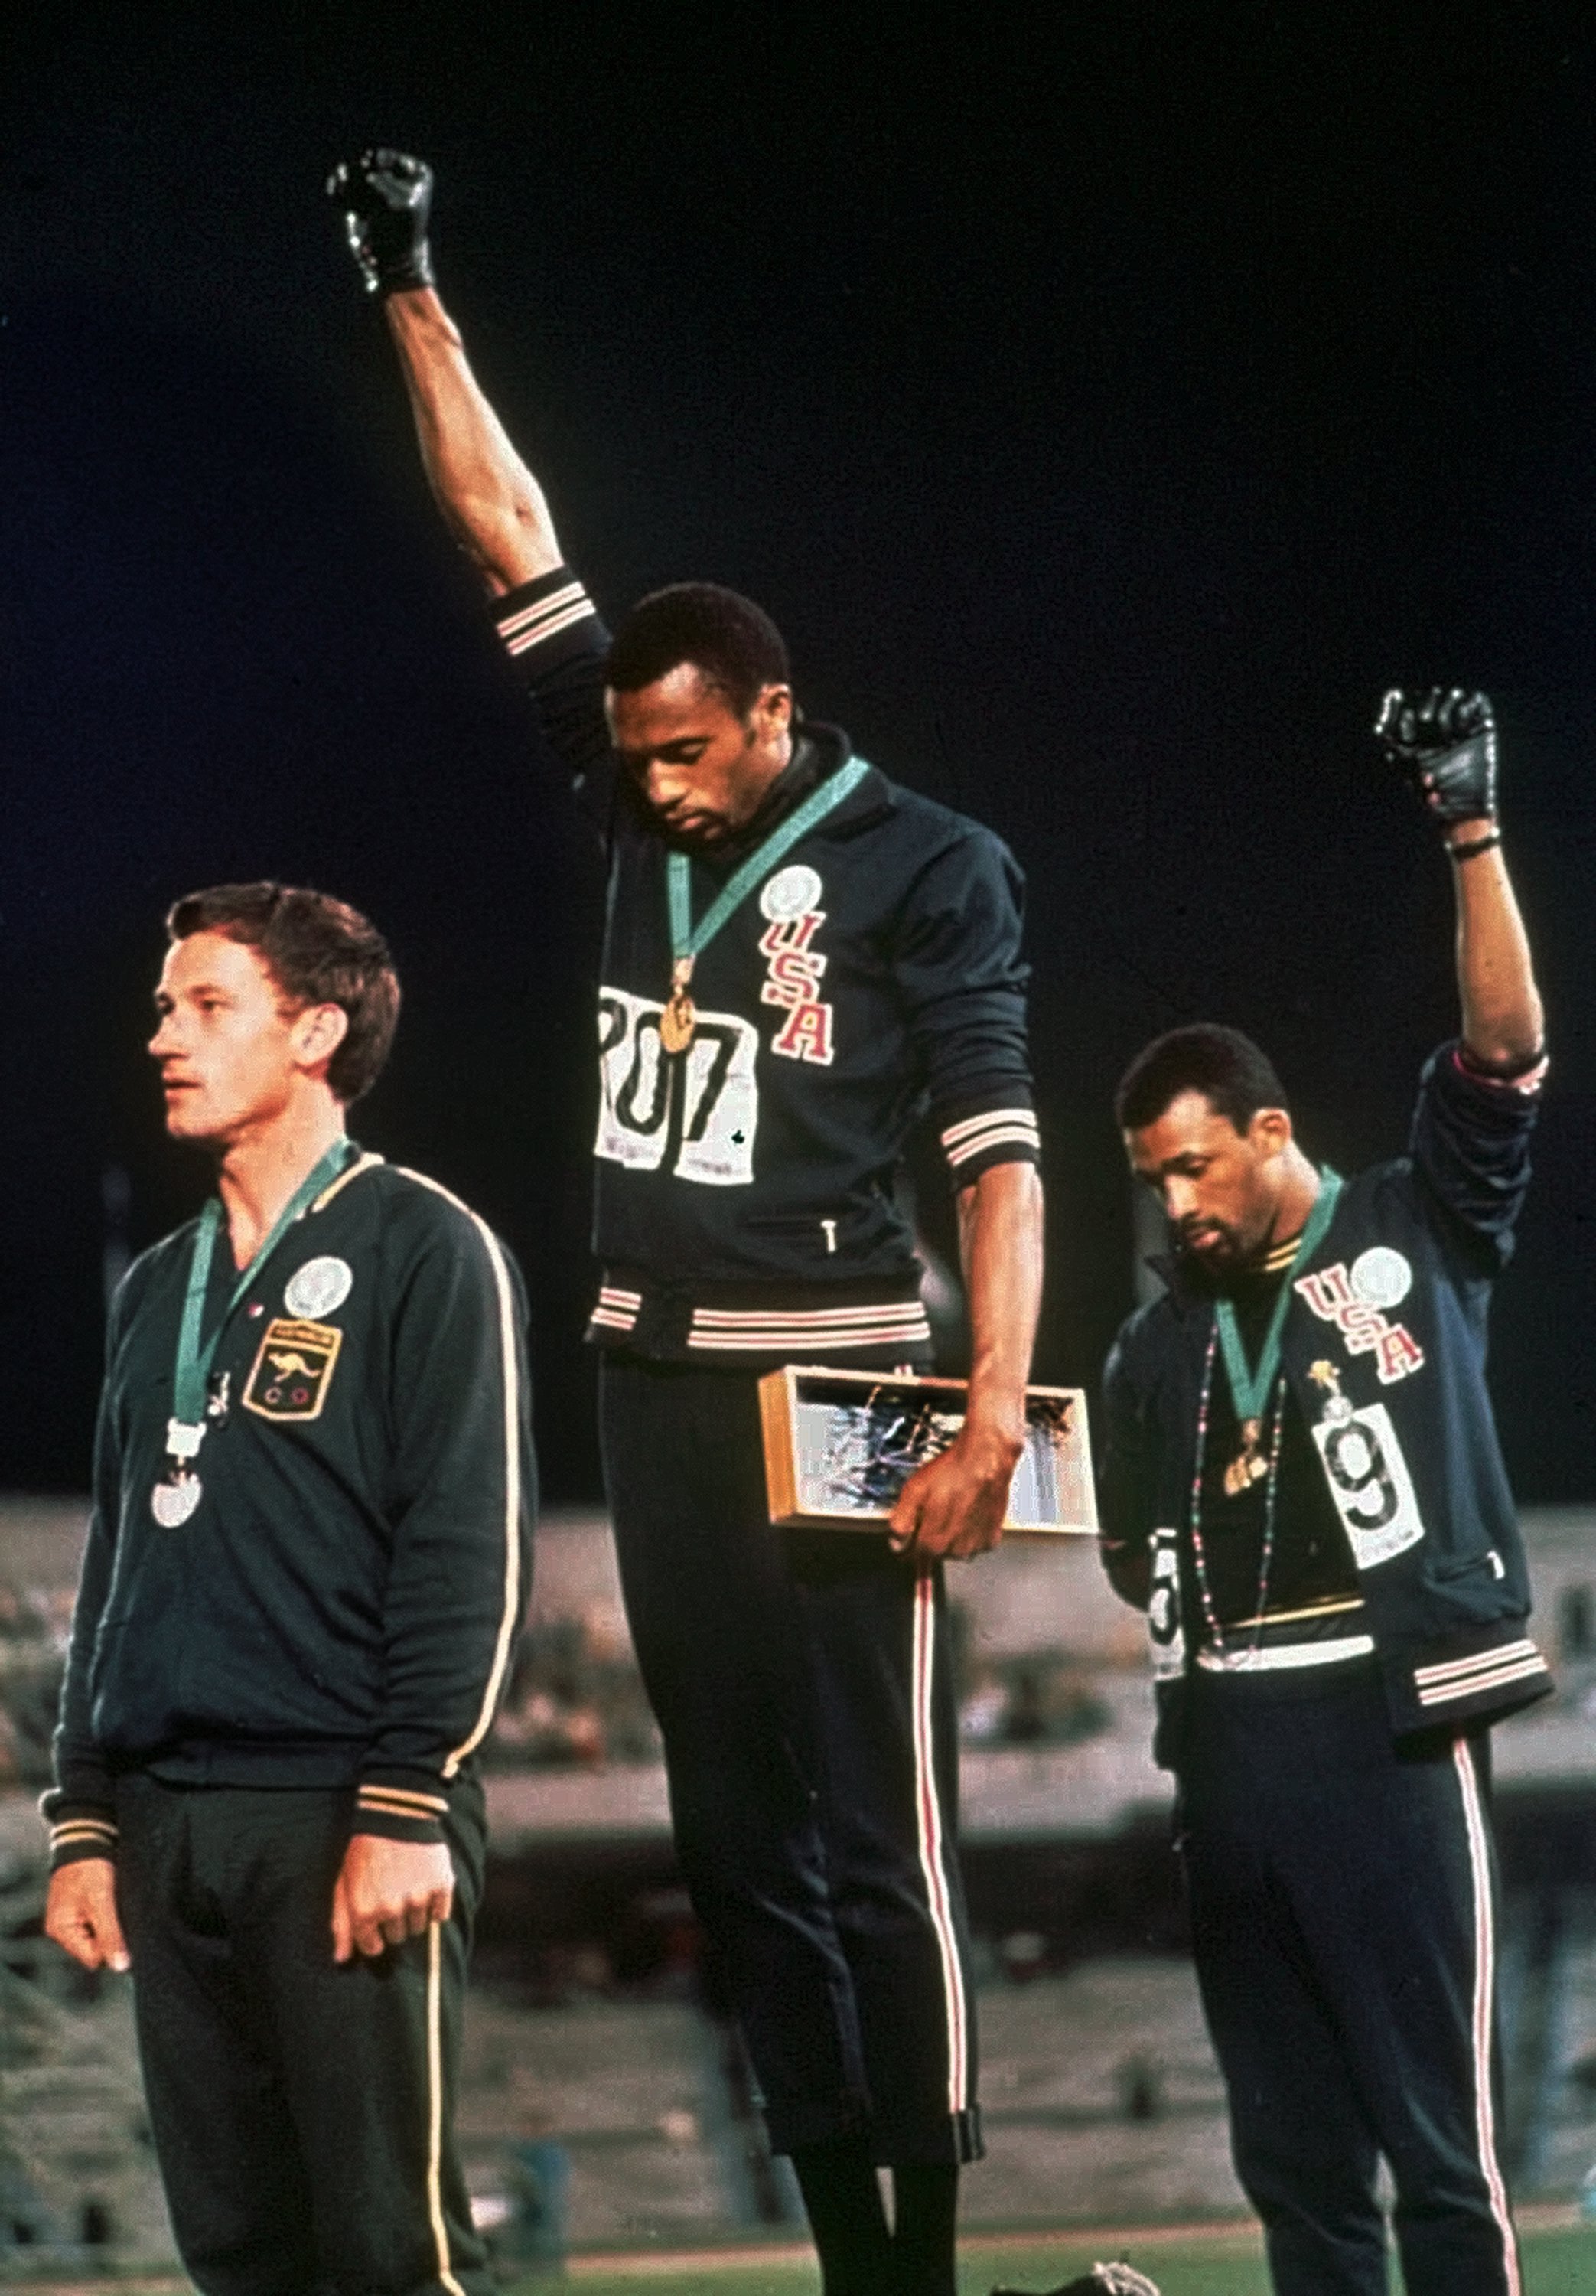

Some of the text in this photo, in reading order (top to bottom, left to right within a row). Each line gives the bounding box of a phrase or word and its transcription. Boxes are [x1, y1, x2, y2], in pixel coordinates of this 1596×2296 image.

[759, 911, 834, 1066] USA
[1294, 1262, 1425, 1385] USA
[1324, 1420, 1398, 1531] 9
